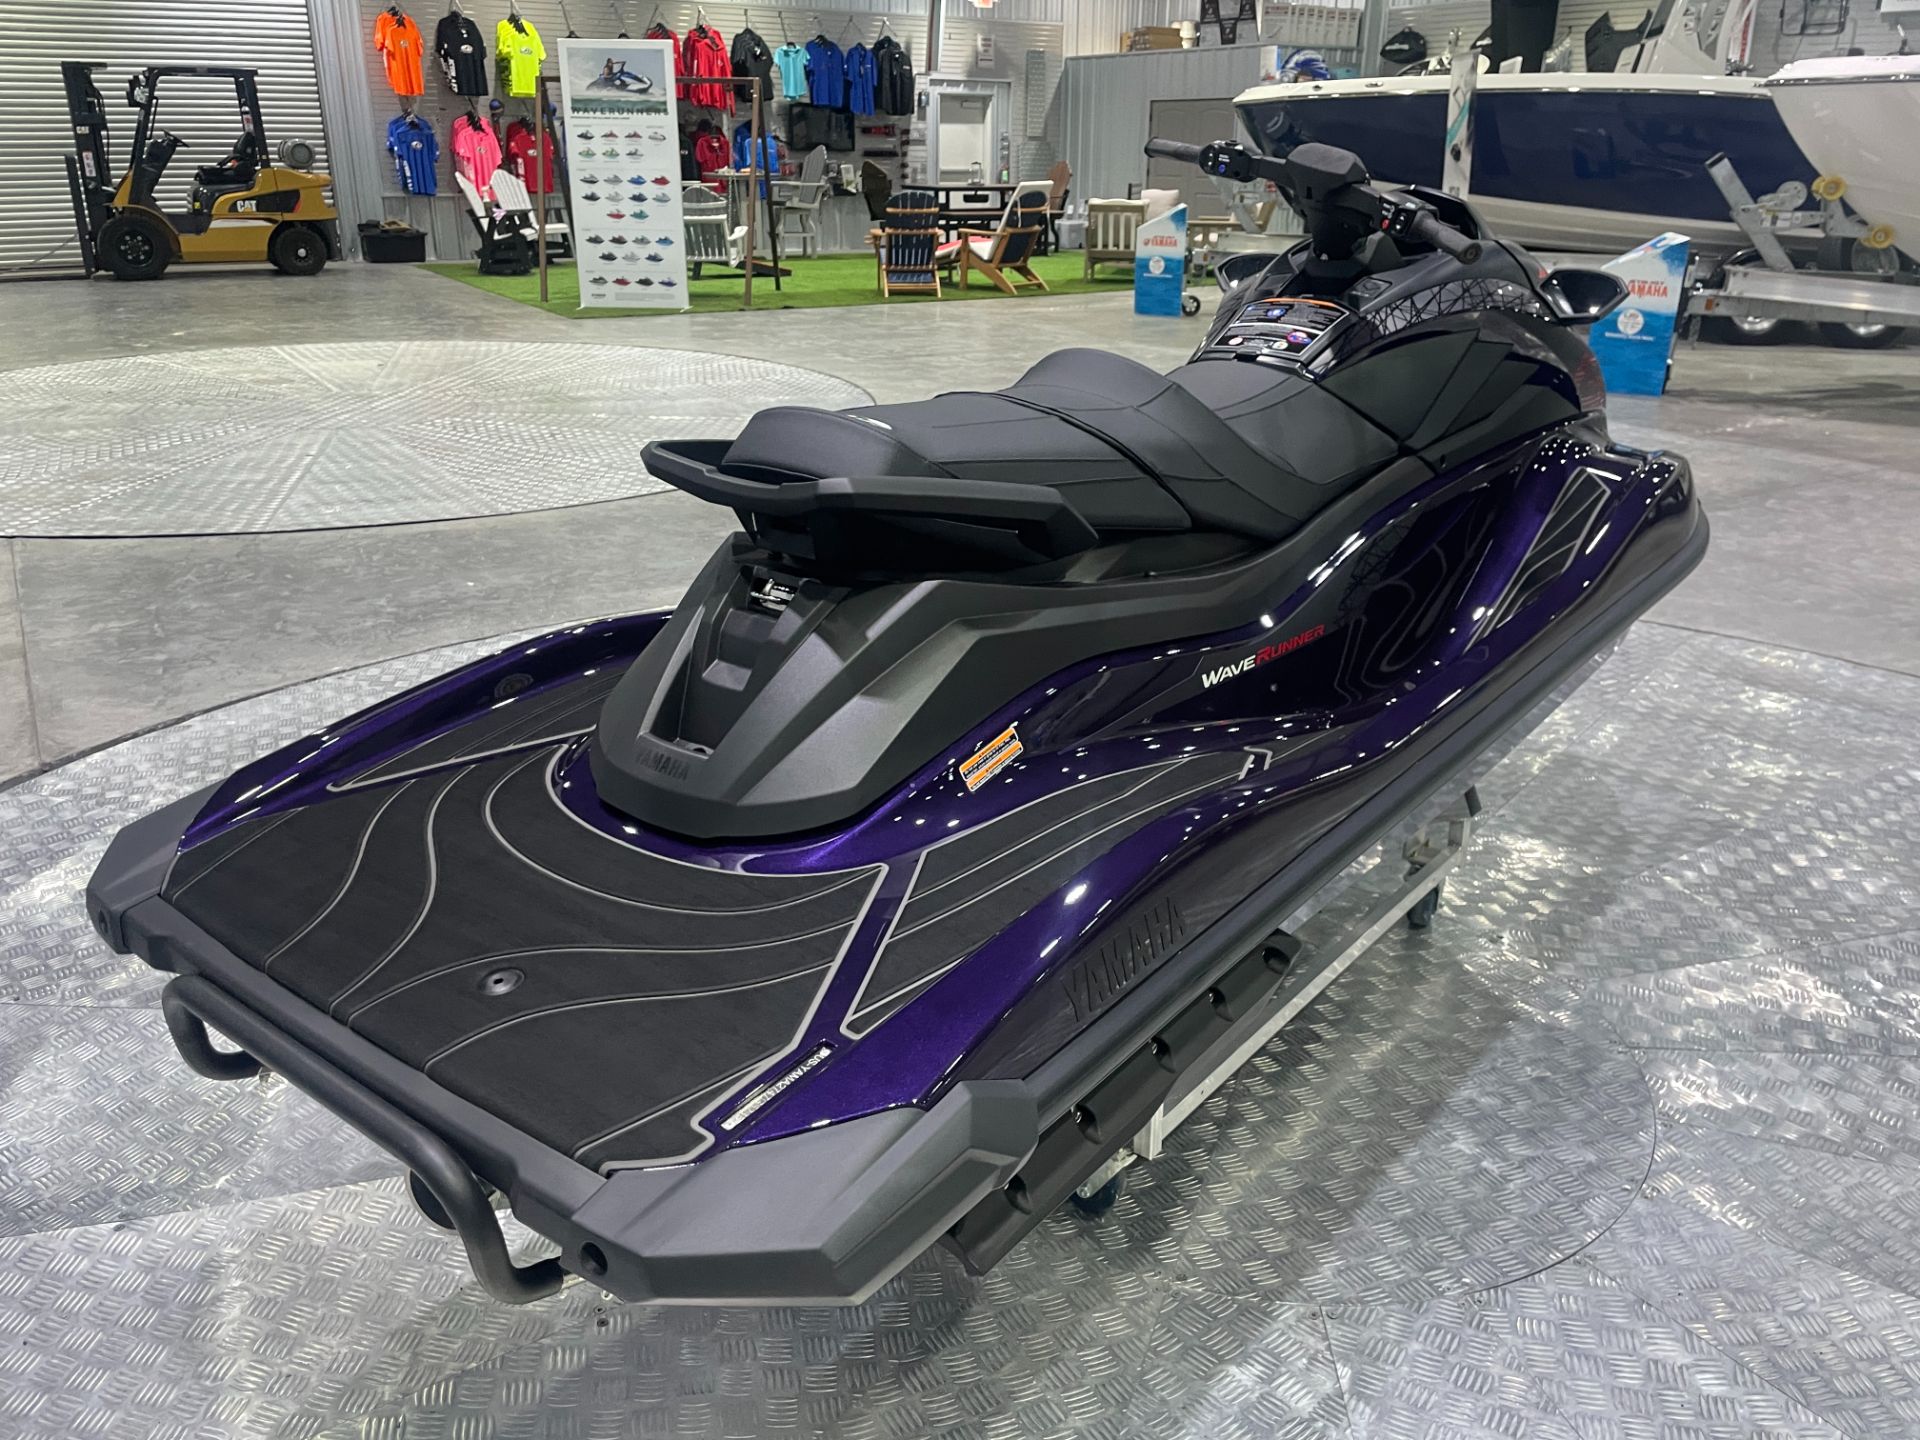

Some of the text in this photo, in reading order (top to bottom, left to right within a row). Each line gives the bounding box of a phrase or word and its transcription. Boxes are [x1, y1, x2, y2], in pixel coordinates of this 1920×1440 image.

[571, 106, 669, 116] WAVERUNNERS
[236, 200, 257, 213] CAT
[1201, 624, 1326, 689] WAVERUNNER
[635, 749, 690, 782] YAMAHA
[1060, 896, 1185, 1023] YAMAHA
